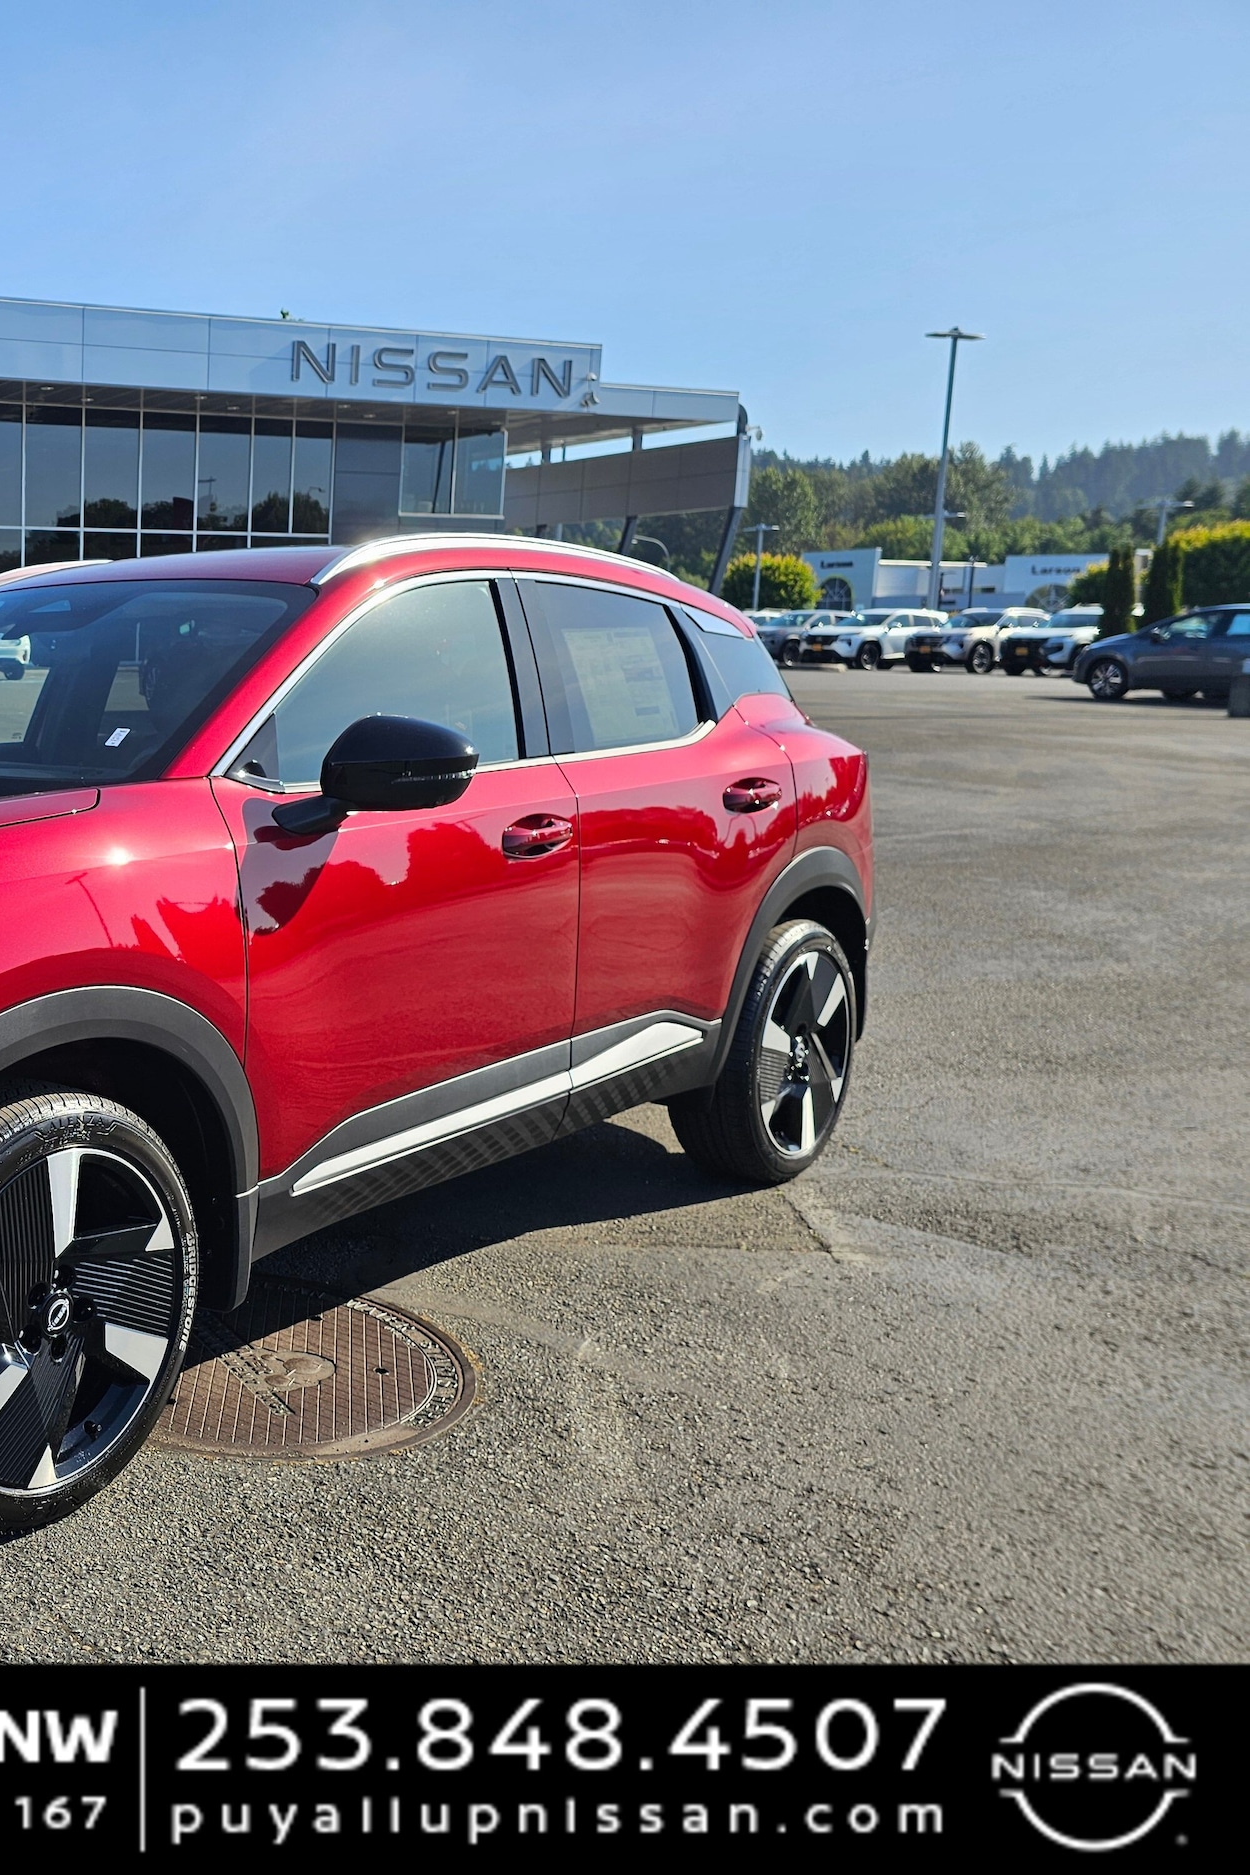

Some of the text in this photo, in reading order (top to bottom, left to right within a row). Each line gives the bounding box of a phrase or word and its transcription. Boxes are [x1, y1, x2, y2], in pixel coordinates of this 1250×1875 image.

[291, 339, 573, 399] NISSAN
[820, 560, 854, 570] Larson
[1031, 564, 1081, 576] Larson
[179, 1231, 199, 1352] BRIDGESTONE
